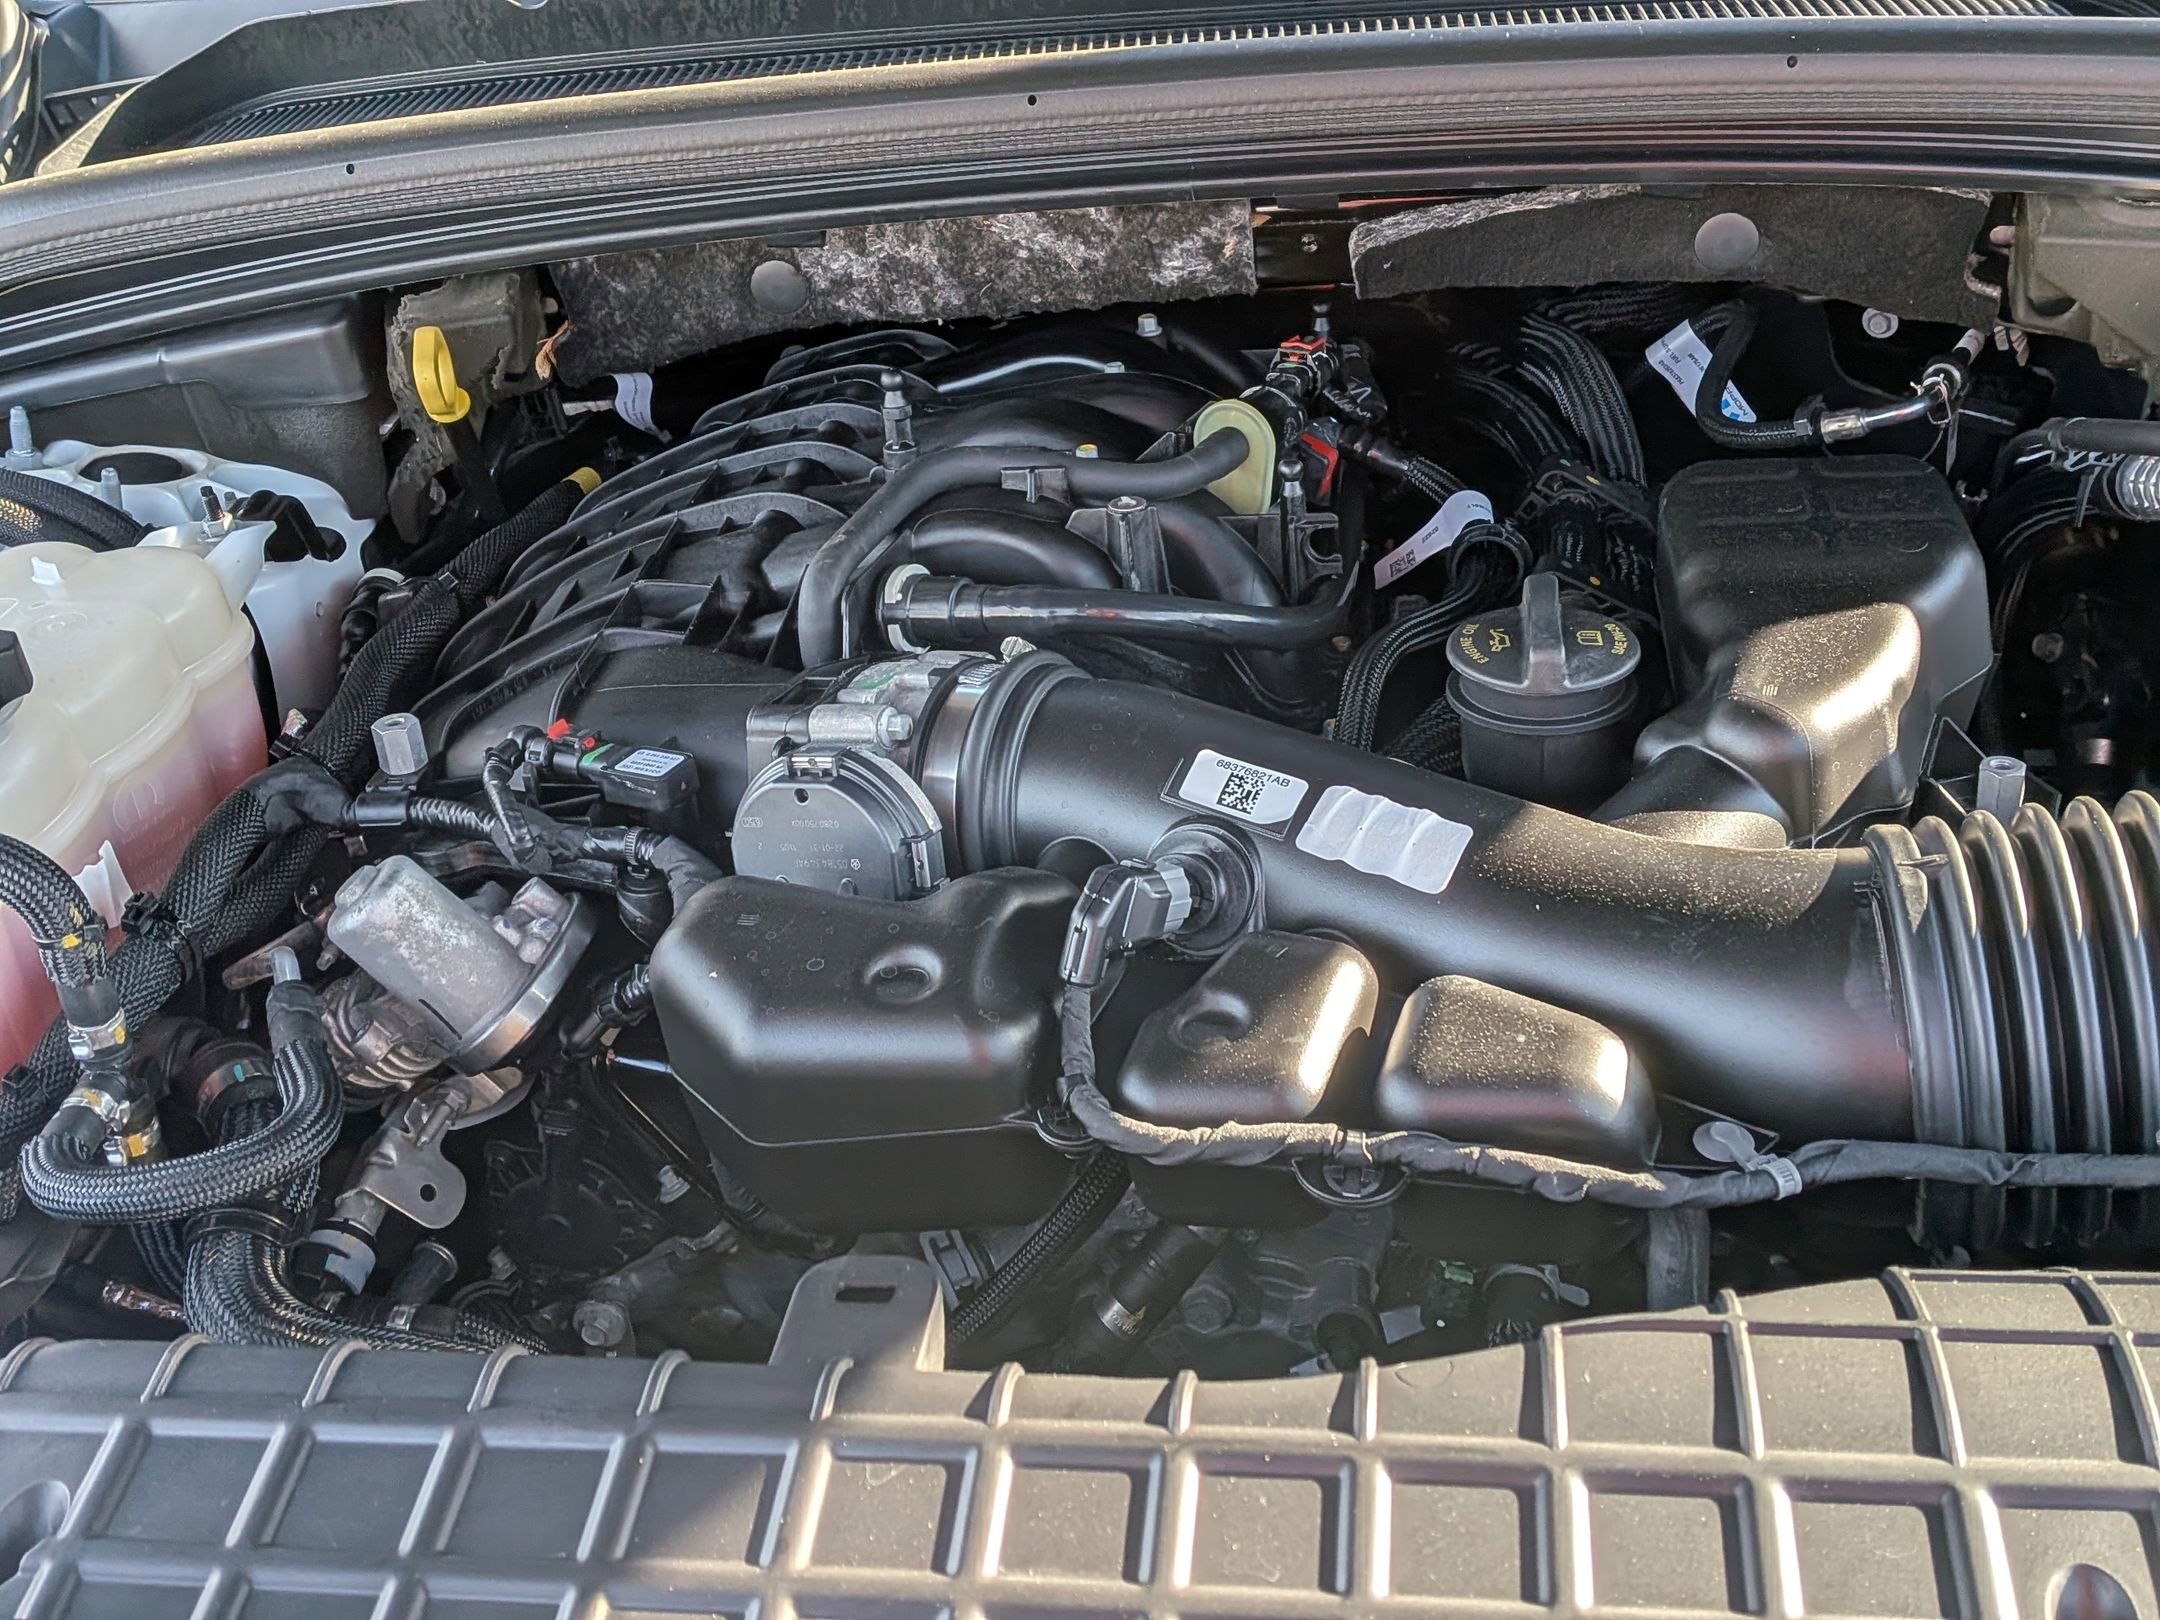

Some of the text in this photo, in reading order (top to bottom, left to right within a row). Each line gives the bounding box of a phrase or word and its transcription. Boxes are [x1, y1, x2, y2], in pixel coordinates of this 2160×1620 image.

[1459, 623, 1490, 664] ENGINE OIL
[1216, 759, 1291, 788] 68376821AB
